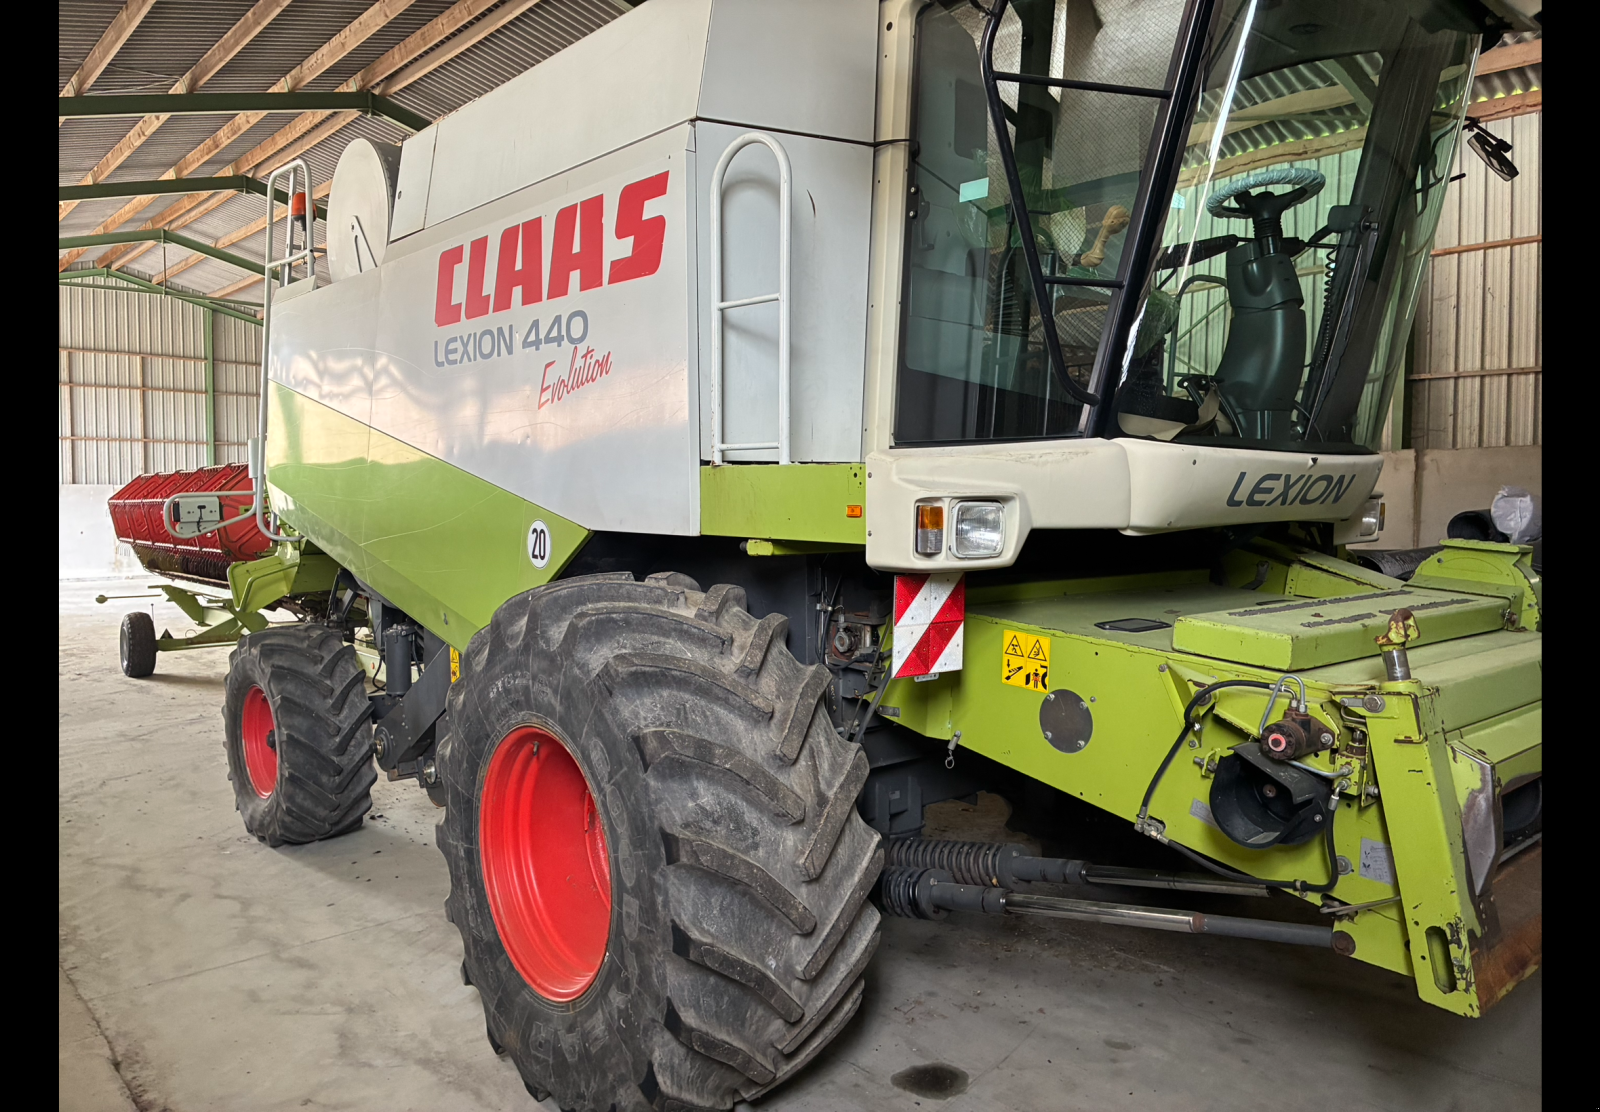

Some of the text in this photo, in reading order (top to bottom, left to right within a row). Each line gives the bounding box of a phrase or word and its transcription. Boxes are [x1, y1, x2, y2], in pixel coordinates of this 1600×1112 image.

[434, 170, 670, 328] CLAAS
[434, 310, 589, 368] LEXION 440
[537, 345, 613, 410] Evolution
[1226, 471, 1356, 507] LEXION
[531, 527, 546, 561] 20
